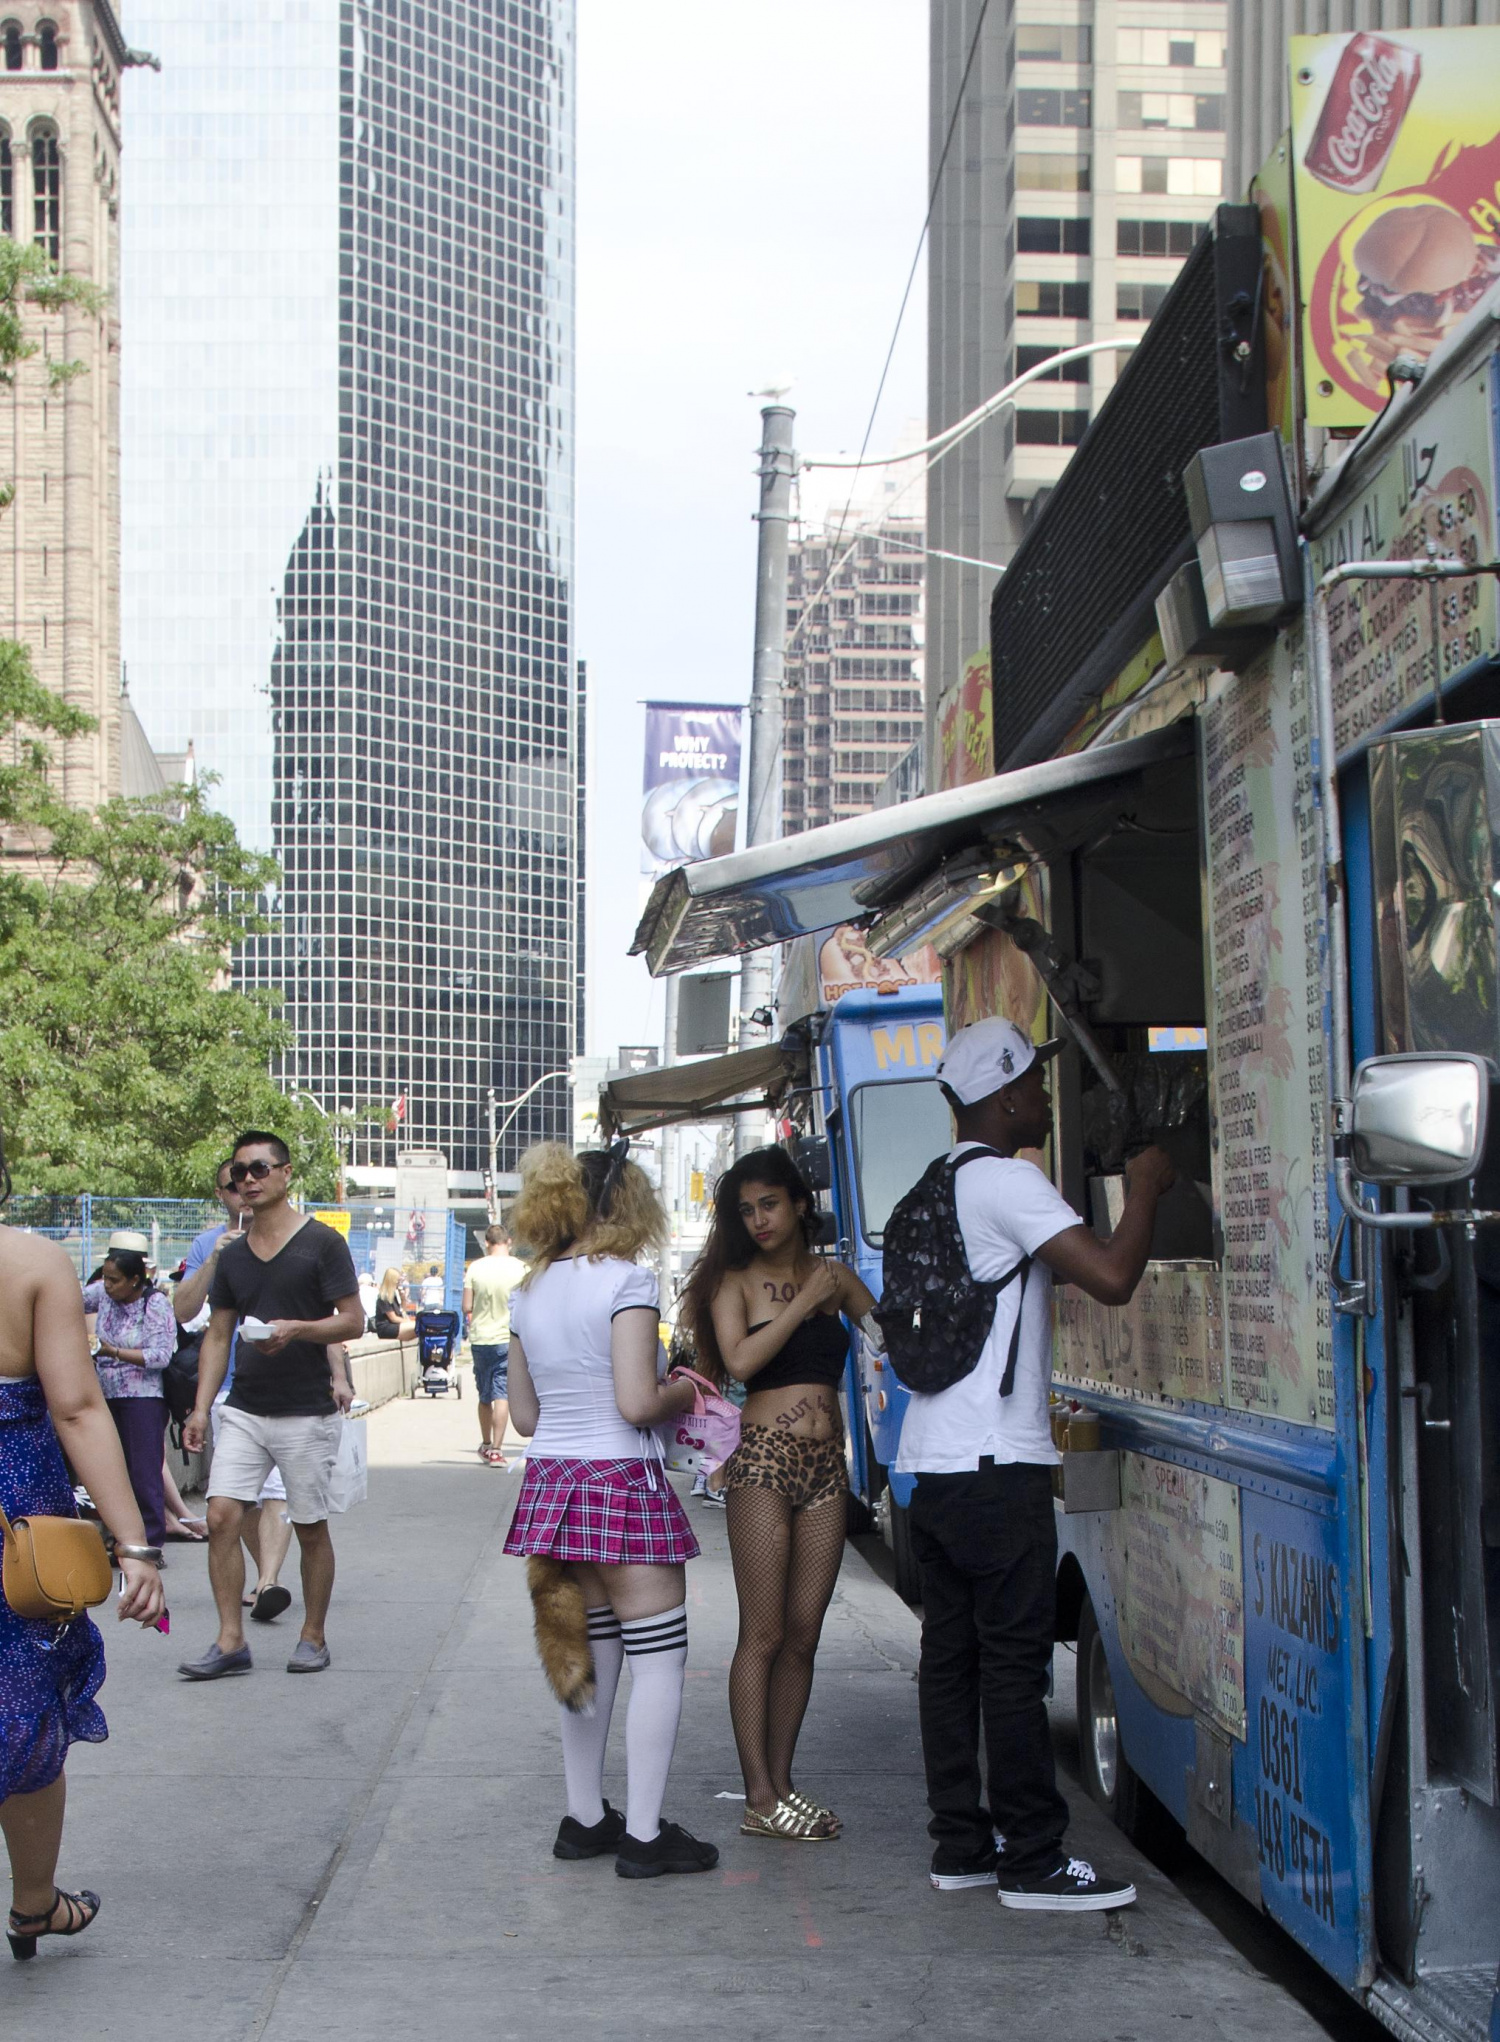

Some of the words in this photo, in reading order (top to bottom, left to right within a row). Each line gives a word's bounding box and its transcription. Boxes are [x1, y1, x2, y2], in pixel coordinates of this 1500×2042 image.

[674, 735, 711, 752] WHY
[659, 752, 728, 771] PROTECT?
[1230, 868, 1263, 898] NUGGETS
[1231, 893, 1264, 923] TENDERS
[871, 1022, 947, 1070] MR
[1254, 1145, 1272, 1166] FRIES
[1253, 1171, 1270, 1191] FRIES
[1254, 1196, 1271, 1217] FRIES
[1250, 1222, 1267, 1241] FRIES
[1245, 1252, 1271, 1273] SAUSAGE
[1244, 1278, 1270, 1298] SAUSAGE
[1249, 1303, 1275, 1324] SAUSAGE
[776, 1397, 812, 1430] SLUT
[1155, 1466, 1189, 1502] SPECIAL
[1253, 1532, 1265, 1617] S
[1270, 1541, 1340, 1656] KAZANIS
[1260, 1695, 1303, 1805] 0361
[1254, 1784, 1285, 1882] 148
[1290, 1811, 1336, 1928] BETA
